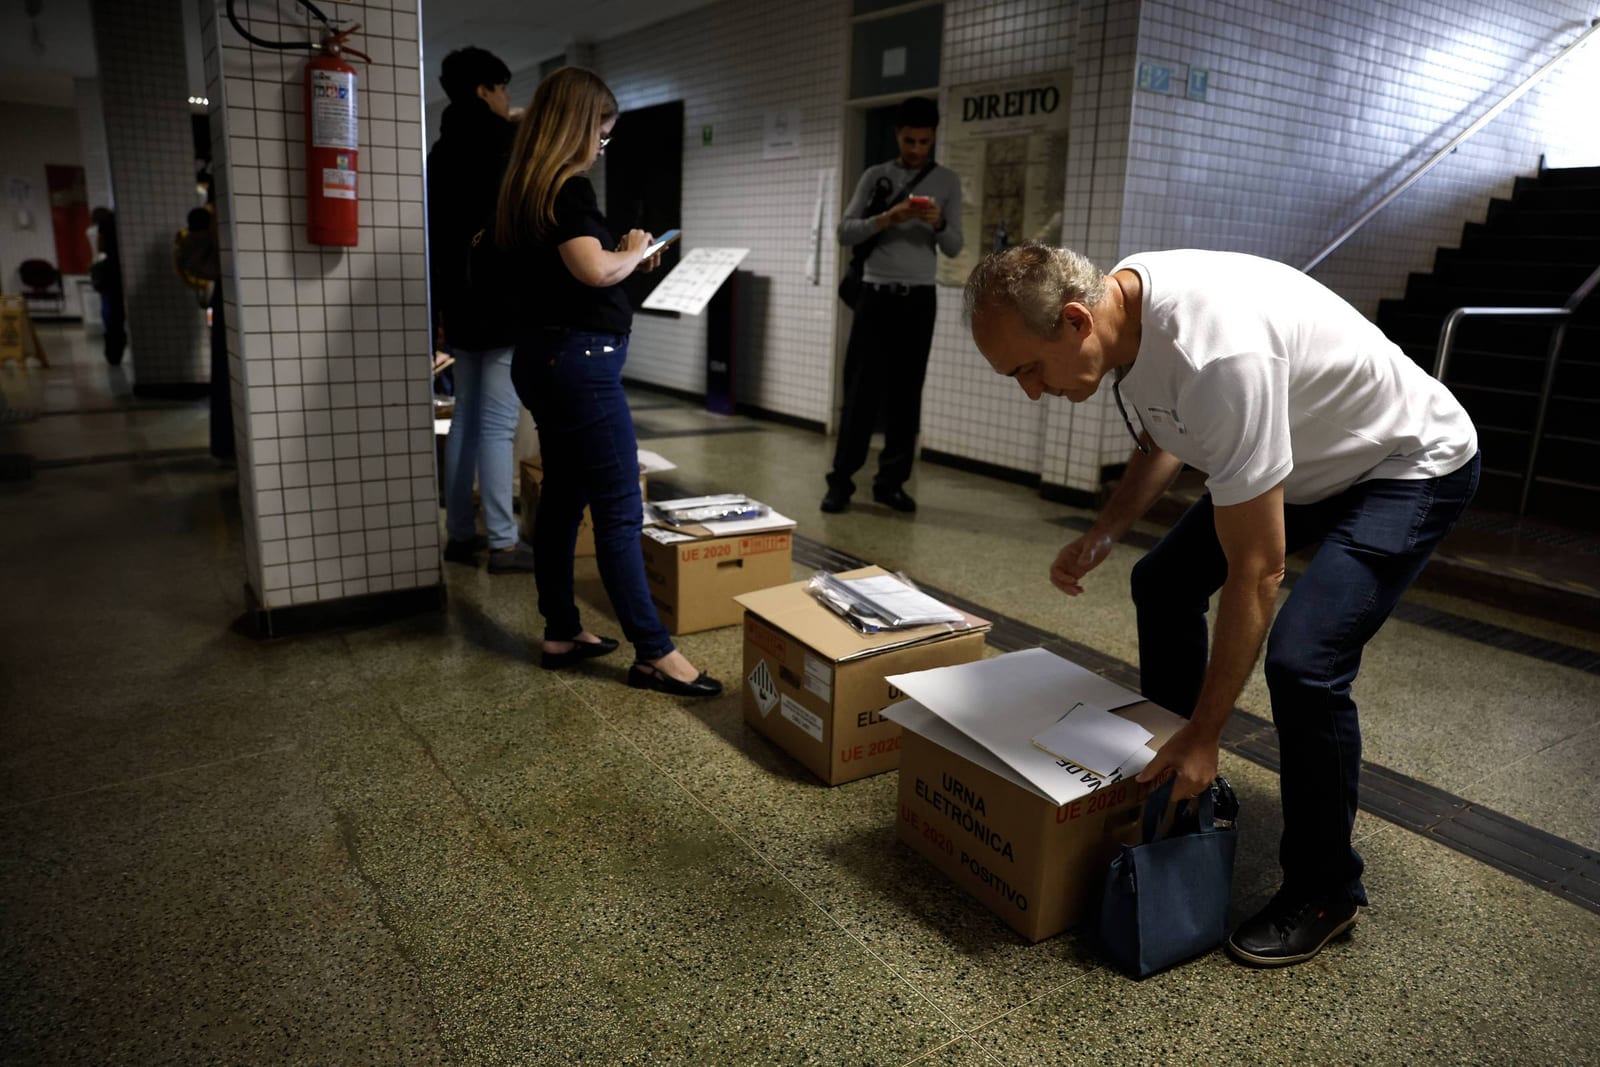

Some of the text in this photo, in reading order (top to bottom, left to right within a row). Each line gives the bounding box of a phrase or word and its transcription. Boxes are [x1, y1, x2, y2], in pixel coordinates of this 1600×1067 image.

[962, 86, 1060, 123] DIREITO
[682, 544, 732, 562] UE 2020
[841, 745, 863, 763] UE
[942, 772, 986, 817] URNA
[1056, 785, 1127, 825] UE 2020
[902, 805, 953, 856] UE 2020
[915, 778, 1014, 863] ELETRÔNICA
[961, 850, 1028, 912] POSITIVO
